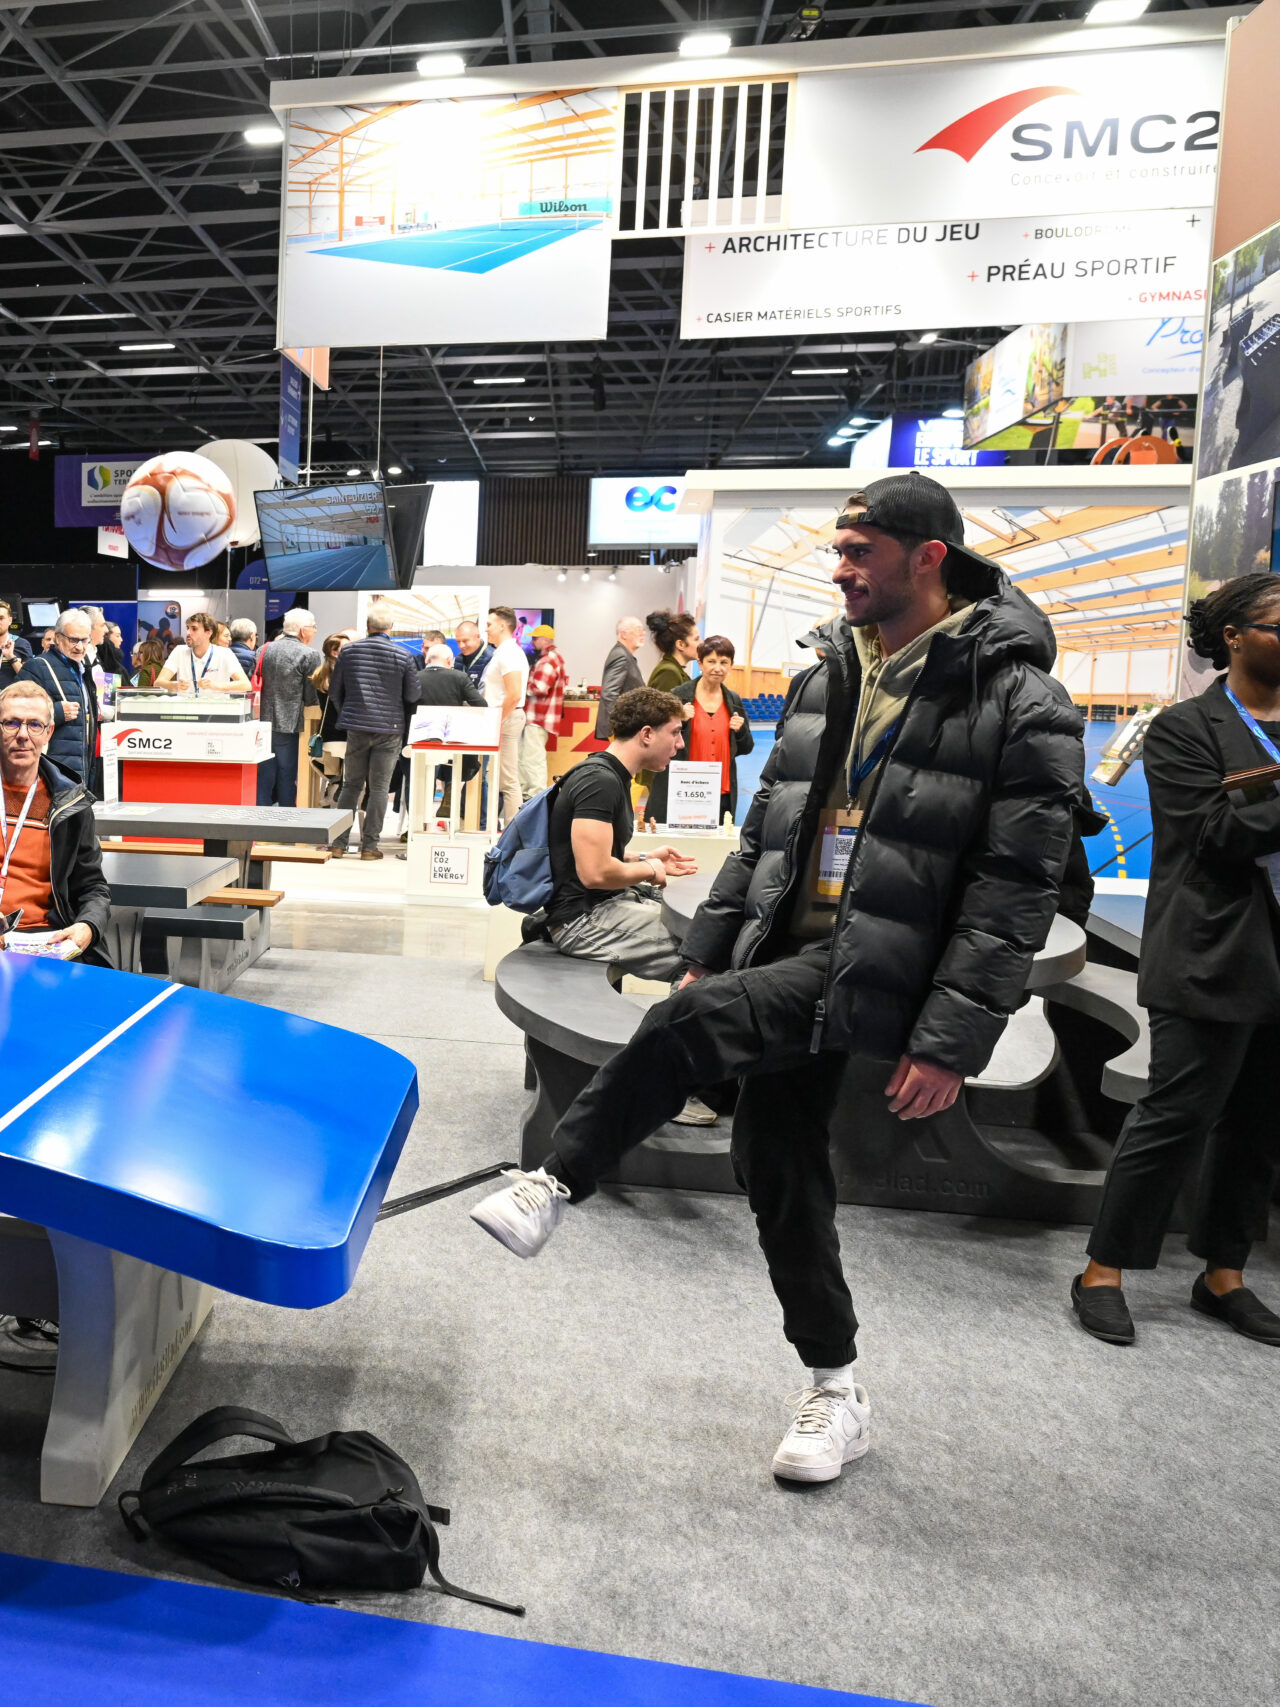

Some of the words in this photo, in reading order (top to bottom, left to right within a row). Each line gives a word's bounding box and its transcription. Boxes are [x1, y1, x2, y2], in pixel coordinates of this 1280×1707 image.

[1010, 110, 1220, 162] SMC2
[540, 201, 587, 214] Wilson
[722, 228, 888, 254] ARCHITECTURE
[897, 226, 928, 244] DU
[935, 222, 980, 242] JEU
[987, 259, 1065, 283] PRÉAU
[1074, 256, 1177, 278] SPORTIF
[706, 311, 753, 324] CASIER
[757, 307, 832, 321] MATÉRIELS
[836, 304, 902, 318] SPORTIFS
[914, 448, 929, 466] LE
[931, 447, 979, 466] SPORT
[127, 738, 173, 750] SMC2
